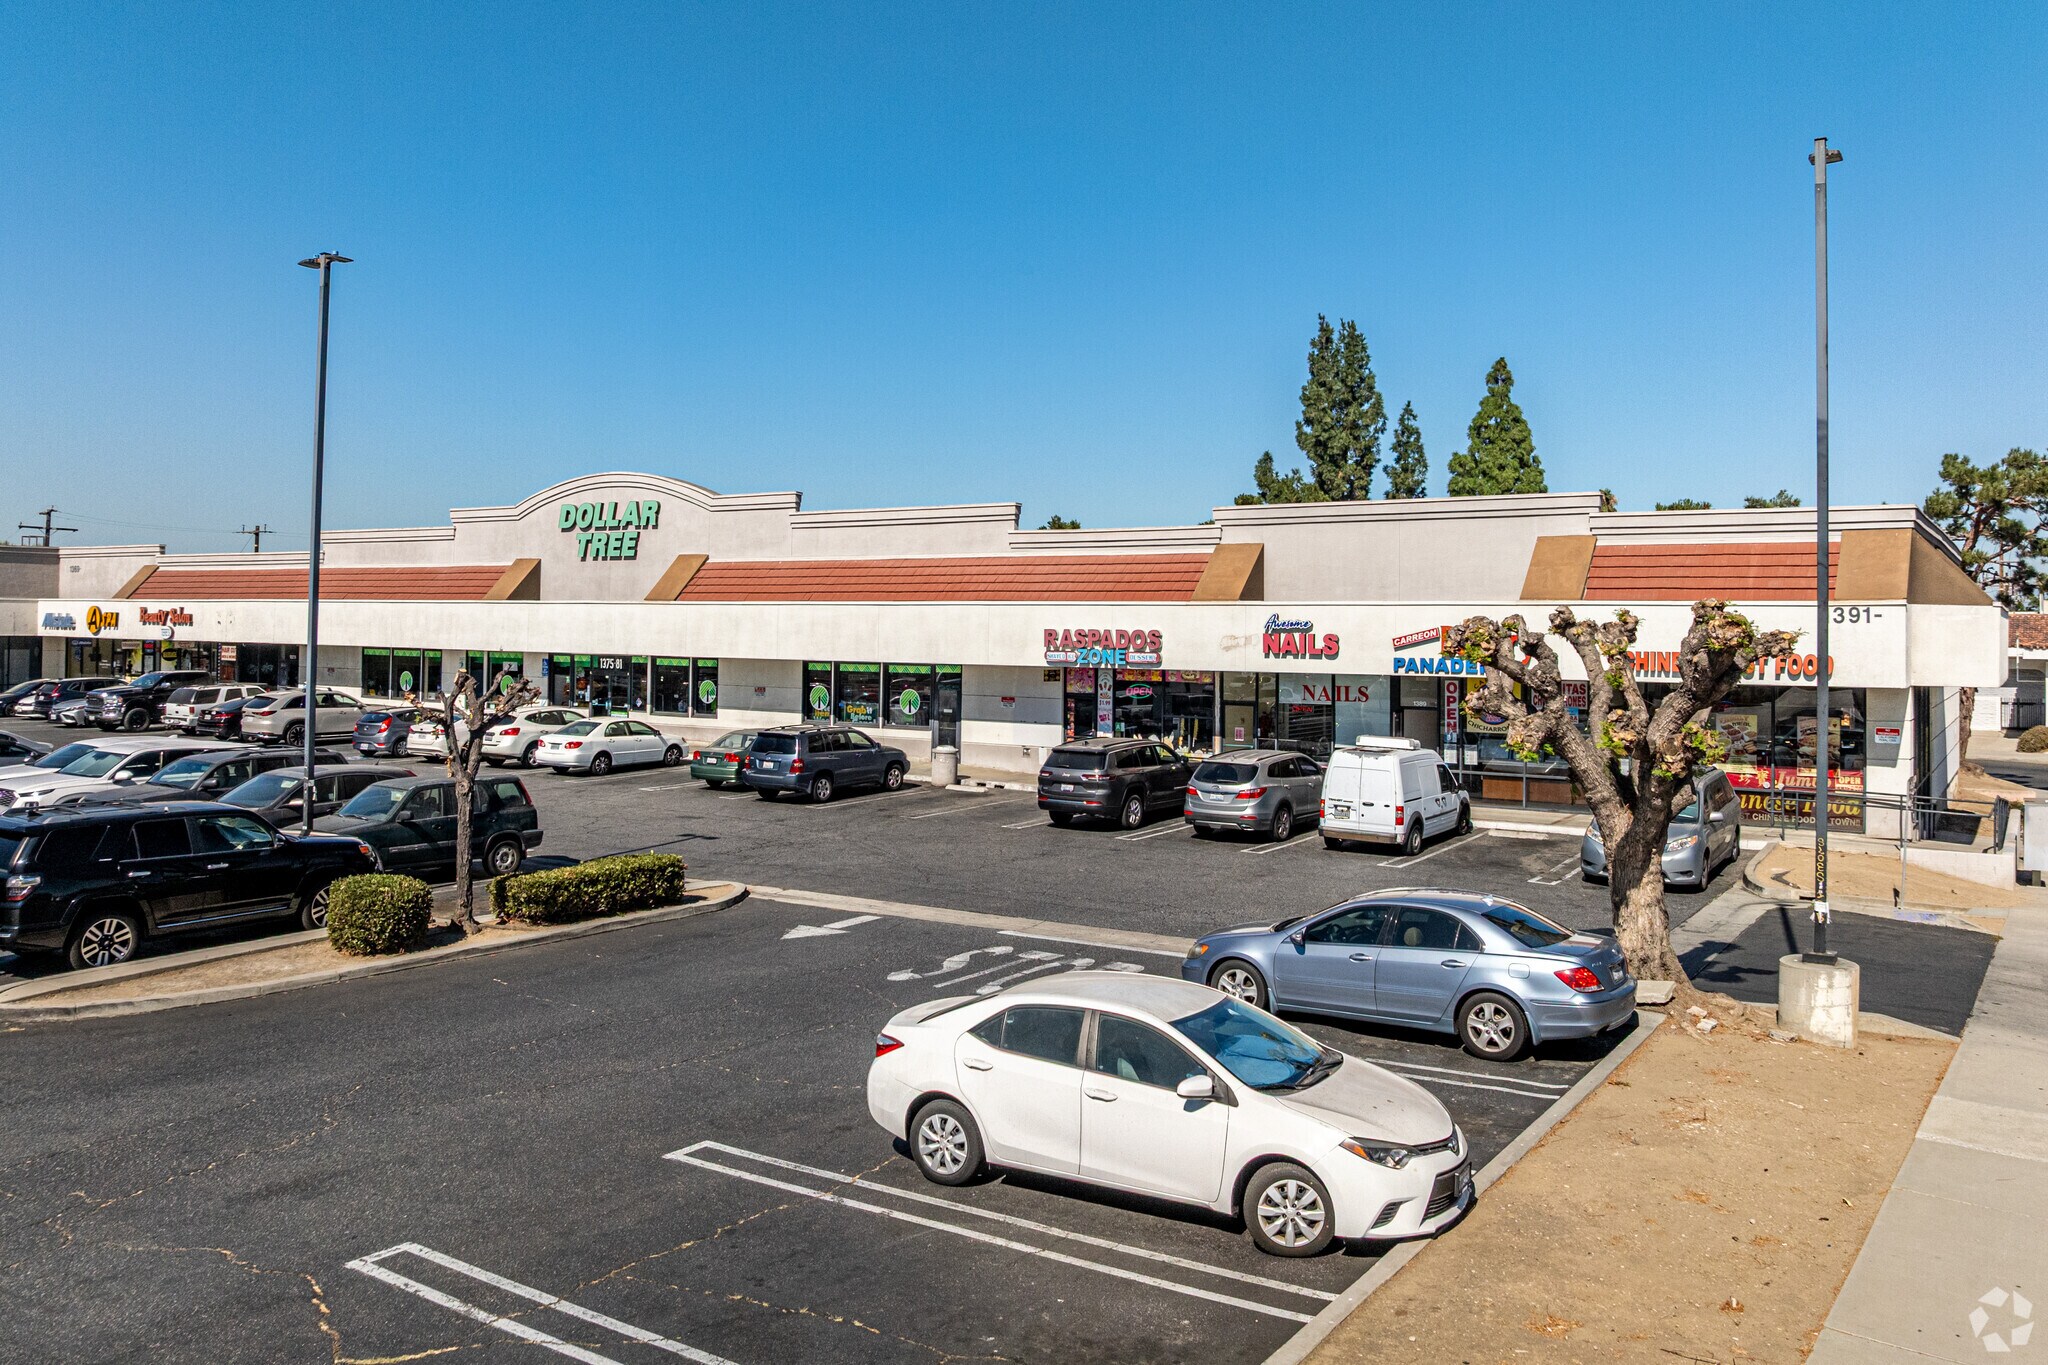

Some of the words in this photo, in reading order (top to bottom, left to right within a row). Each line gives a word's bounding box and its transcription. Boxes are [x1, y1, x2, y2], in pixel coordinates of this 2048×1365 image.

[558, 500, 662, 531] DOLLAR
[576, 531, 639, 559] TREE
[139, 607, 168, 626] Beauty
[169, 607, 192, 624] Salon
[1264, 613, 1312, 632] Awesome
[1043, 629, 1163, 650] RASPADOS
[1262, 633, 1339, 656] NAILS
[1394, 629, 1438, 647] CARREON
[1076, 648, 1127, 665] ZONE
[1393, 657, 1486, 675] PANADE
[1125, 687, 1153, 697] OPEN
[1302, 684, 1370, 703] NAILS
[846, 704, 867, 715] Grab
[1446, 681, 1458, 733] OPEN
[1838, 776, 1861, 785] OPEN
